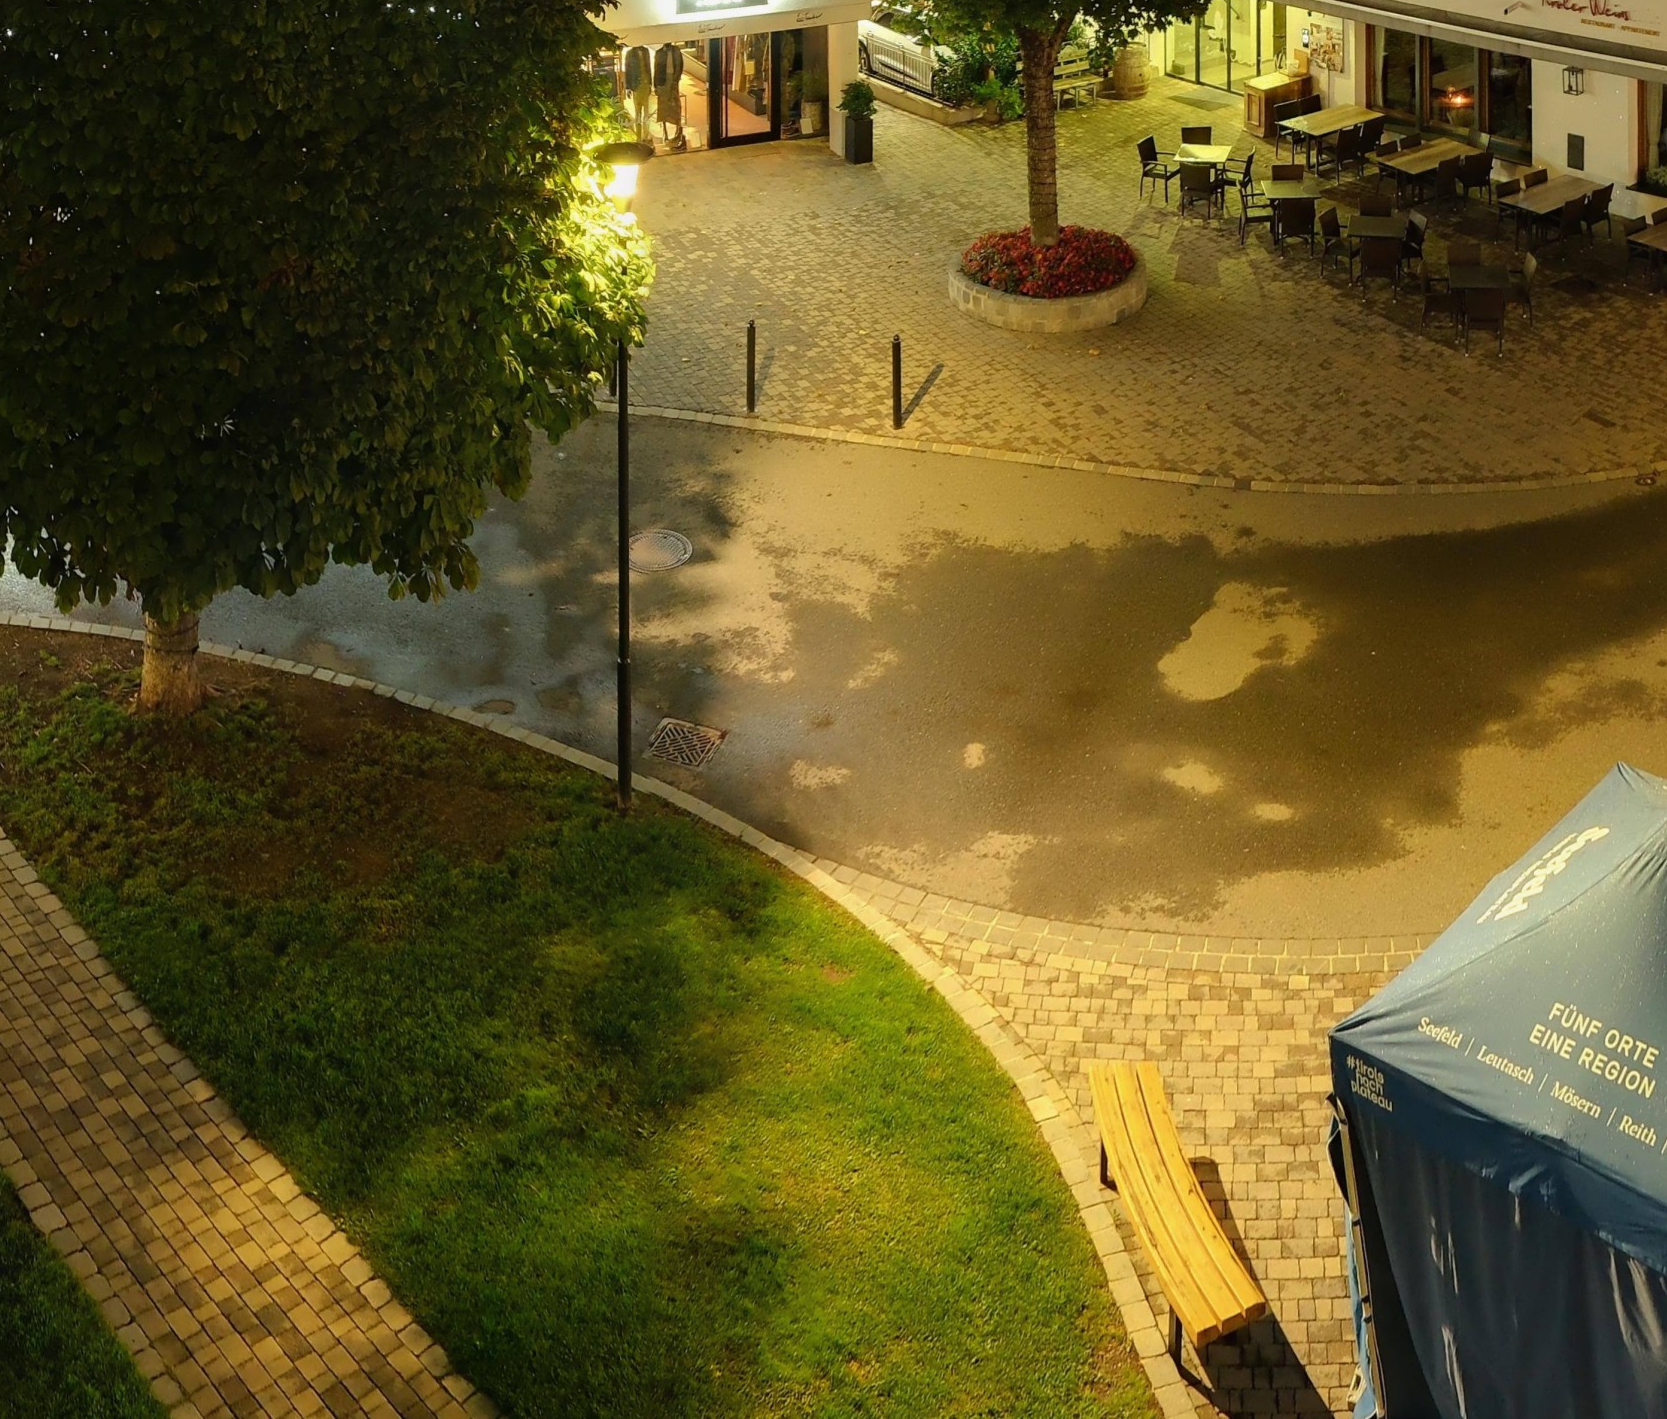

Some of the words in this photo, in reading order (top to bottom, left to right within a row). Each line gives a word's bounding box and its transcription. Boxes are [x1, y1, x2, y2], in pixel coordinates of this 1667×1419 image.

[1548, 1000, 1603, 1039] FÜNF
[1604, 1029, 1660, 1069] ORTE
[1346, 1054, 1385, 1084] #tirols
[1355, 1068, 1383, 1096] hoch
[1417, 1015, 1464, 1050] Seefeld
[1475, 1044, 1535, 1085] Leutasch
[1550, 1080, 1603, 1119] Mösern
[1618, 1114, 1658, 1147] Reith
[1529, 1023, 1577, 1059] EINE
[1578, 1048, 1656, 1099] REGION
[1350, 1080, 1393, 1113] plateau
